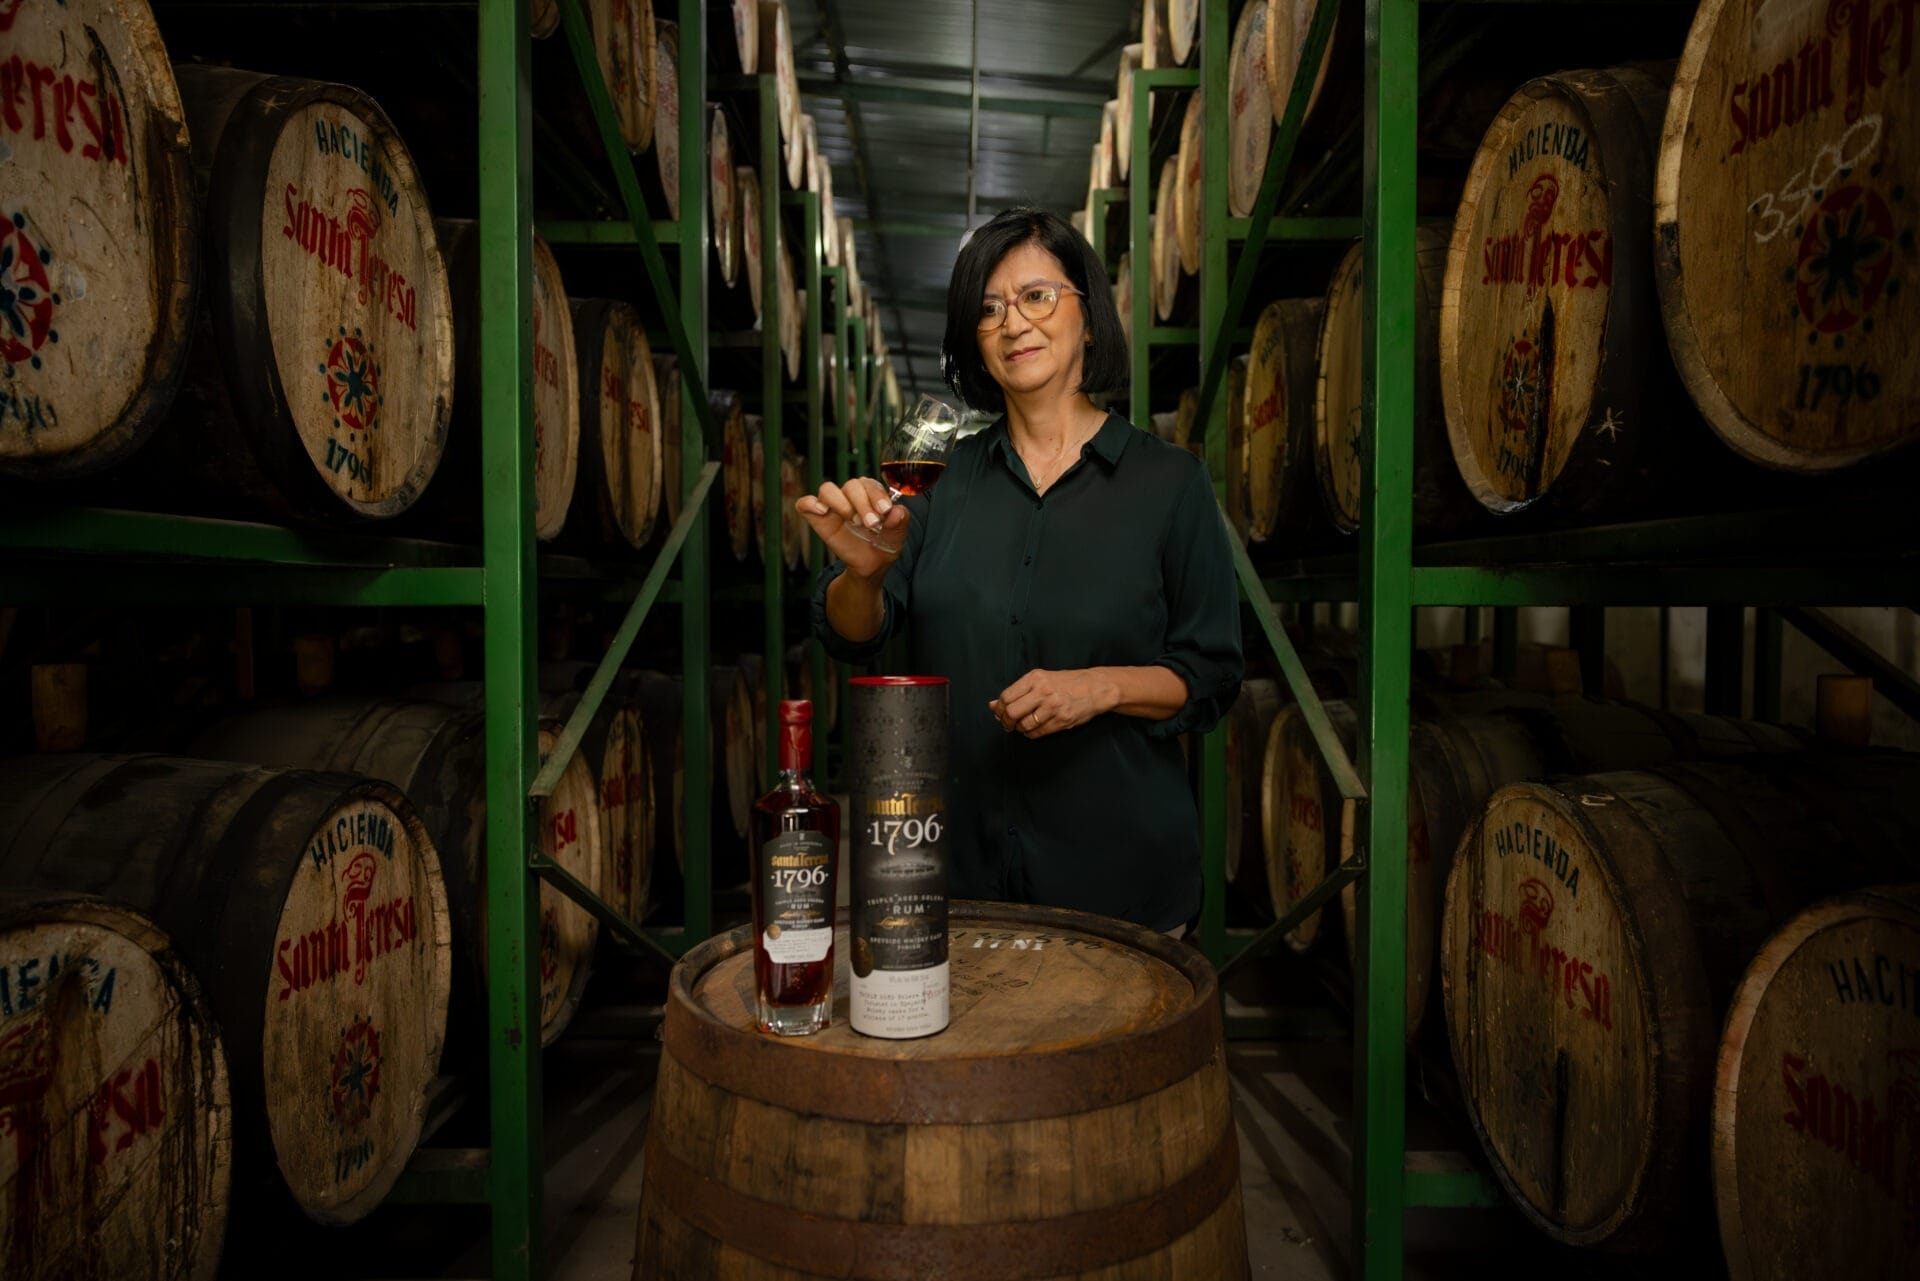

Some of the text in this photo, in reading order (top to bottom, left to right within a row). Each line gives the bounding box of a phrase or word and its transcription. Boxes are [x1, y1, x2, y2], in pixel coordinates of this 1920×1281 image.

[316, 120, 399, 218] HACIENDA
[1509, 123, 1589, 179] HACIENDA
[1797, 362, 1880, 411] 1796
[326, 438, 373, 491] 1796
[311, 812, 394, 872] HACIENDA
[871, 813, 940, 856] 1796
[1496, 822, 1580, 897] HACIENDA
[278, 853, 416, 1001] Santa Teresa
[893, 904, 924, 915] RUM
